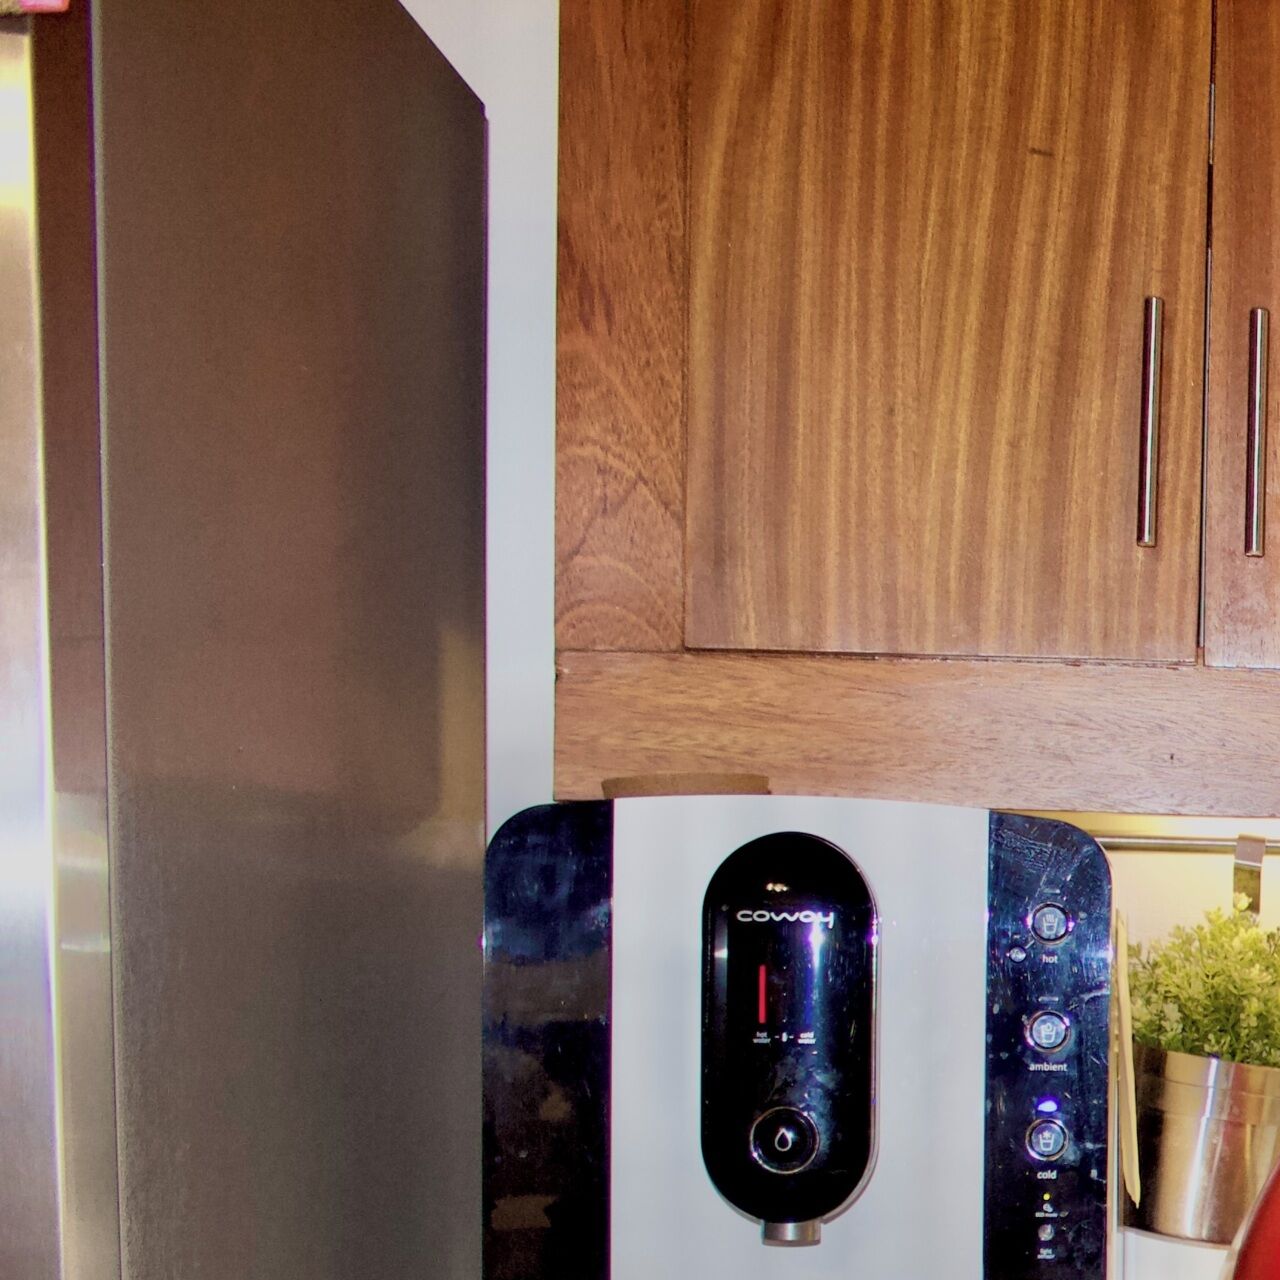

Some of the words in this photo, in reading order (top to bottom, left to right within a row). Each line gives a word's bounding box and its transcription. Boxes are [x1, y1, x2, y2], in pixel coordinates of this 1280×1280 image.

[736, 910, 835, 929] coway
[1042, 955, 1058, 964] hot
[1029, 1062, 1068, 1072] ambient
[1036, 1169, 1057, 1180] cold
